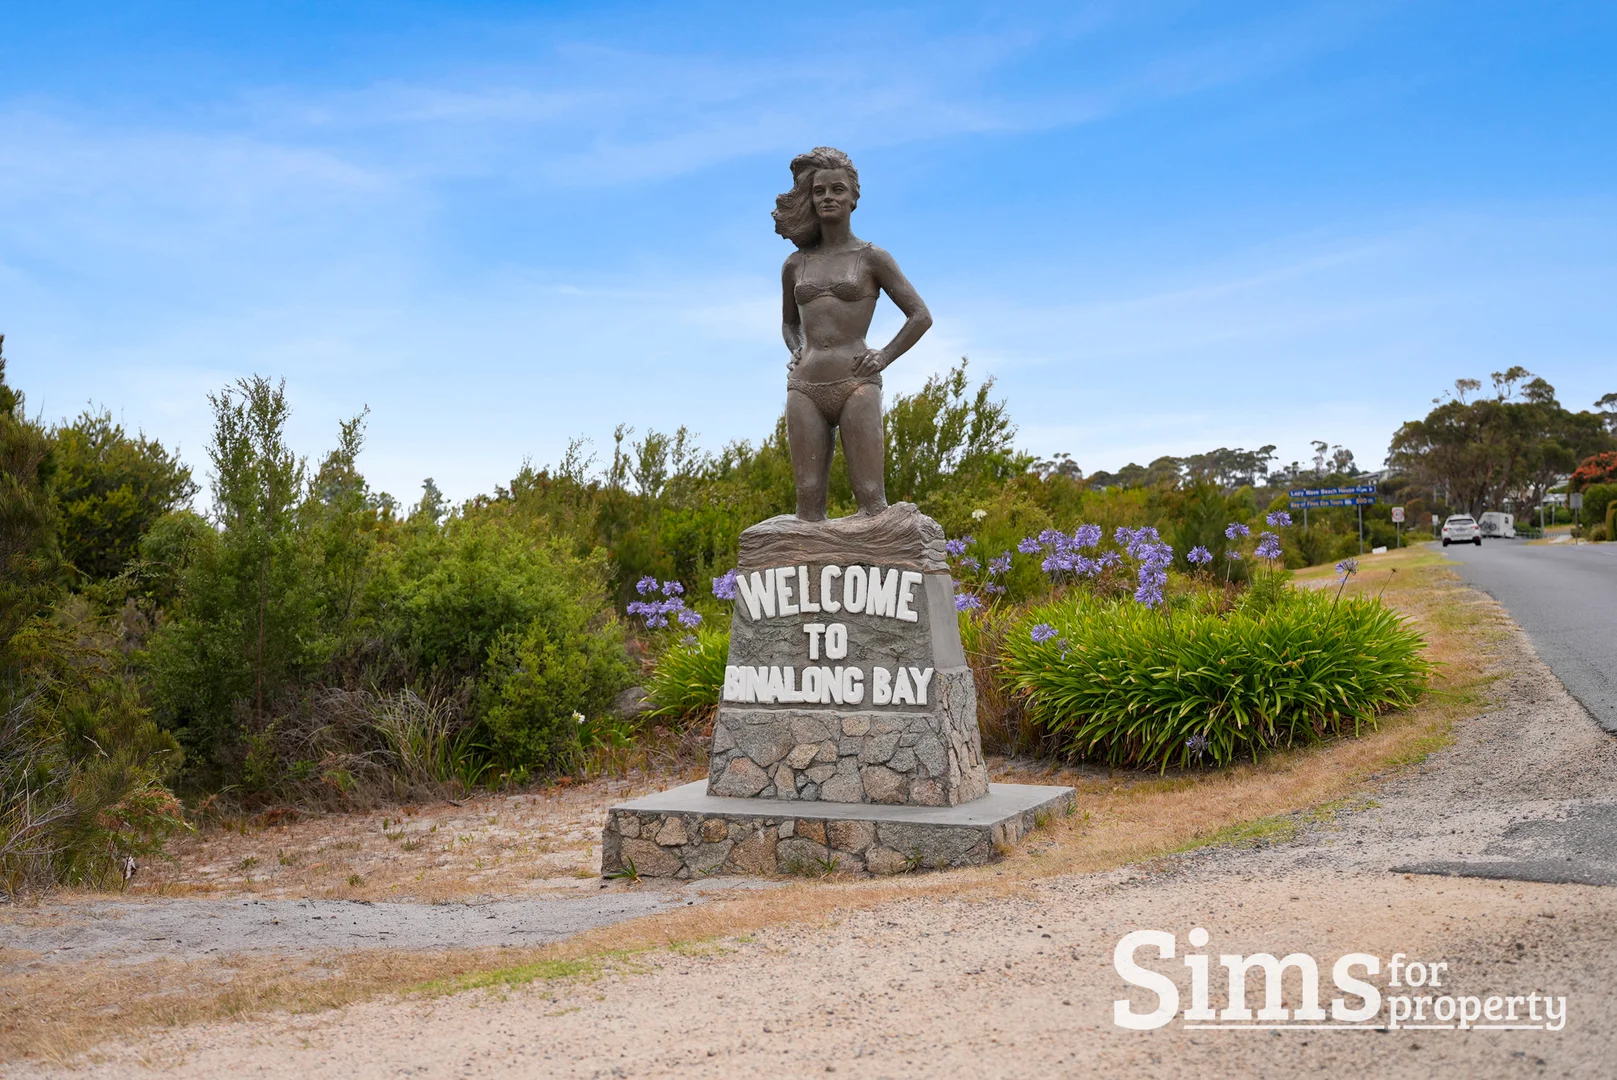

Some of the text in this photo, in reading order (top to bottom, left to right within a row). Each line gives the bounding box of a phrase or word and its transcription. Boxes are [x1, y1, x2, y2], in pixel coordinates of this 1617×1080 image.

[736, 564, 923, 623] WELCOME
[803, 623, 848, 660] TO
[723, 665, 934, 706] BINALONG BAY
